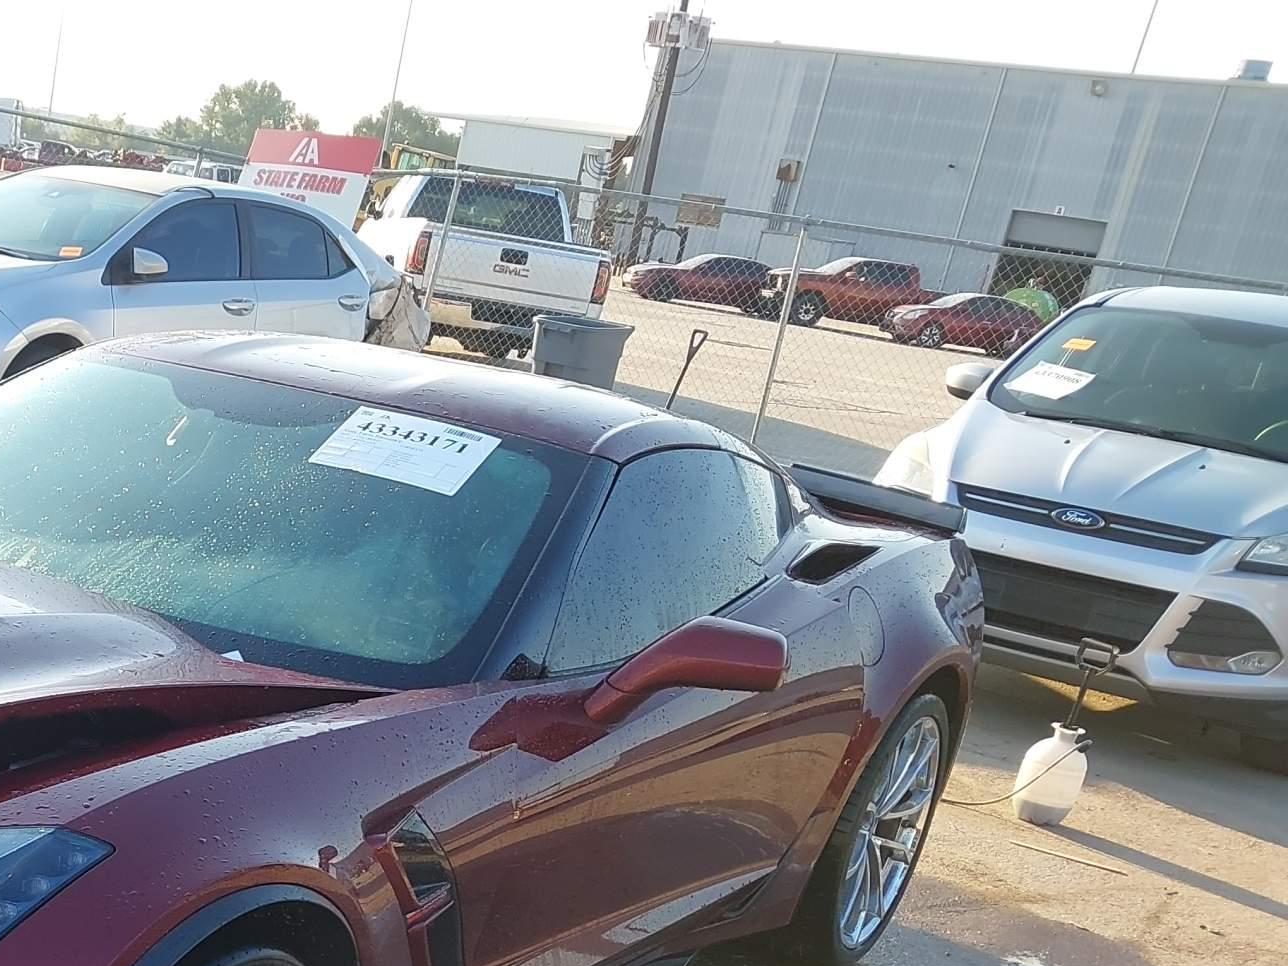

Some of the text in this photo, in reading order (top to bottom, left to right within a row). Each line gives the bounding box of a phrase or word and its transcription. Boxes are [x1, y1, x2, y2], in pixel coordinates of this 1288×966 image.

[253, 168, 347, 195] STATE FARM
[493, 263, 530, 278] GMC
[357, 421, 468, 453] 43343171
[1062, 510, 1093, 526] Ford
